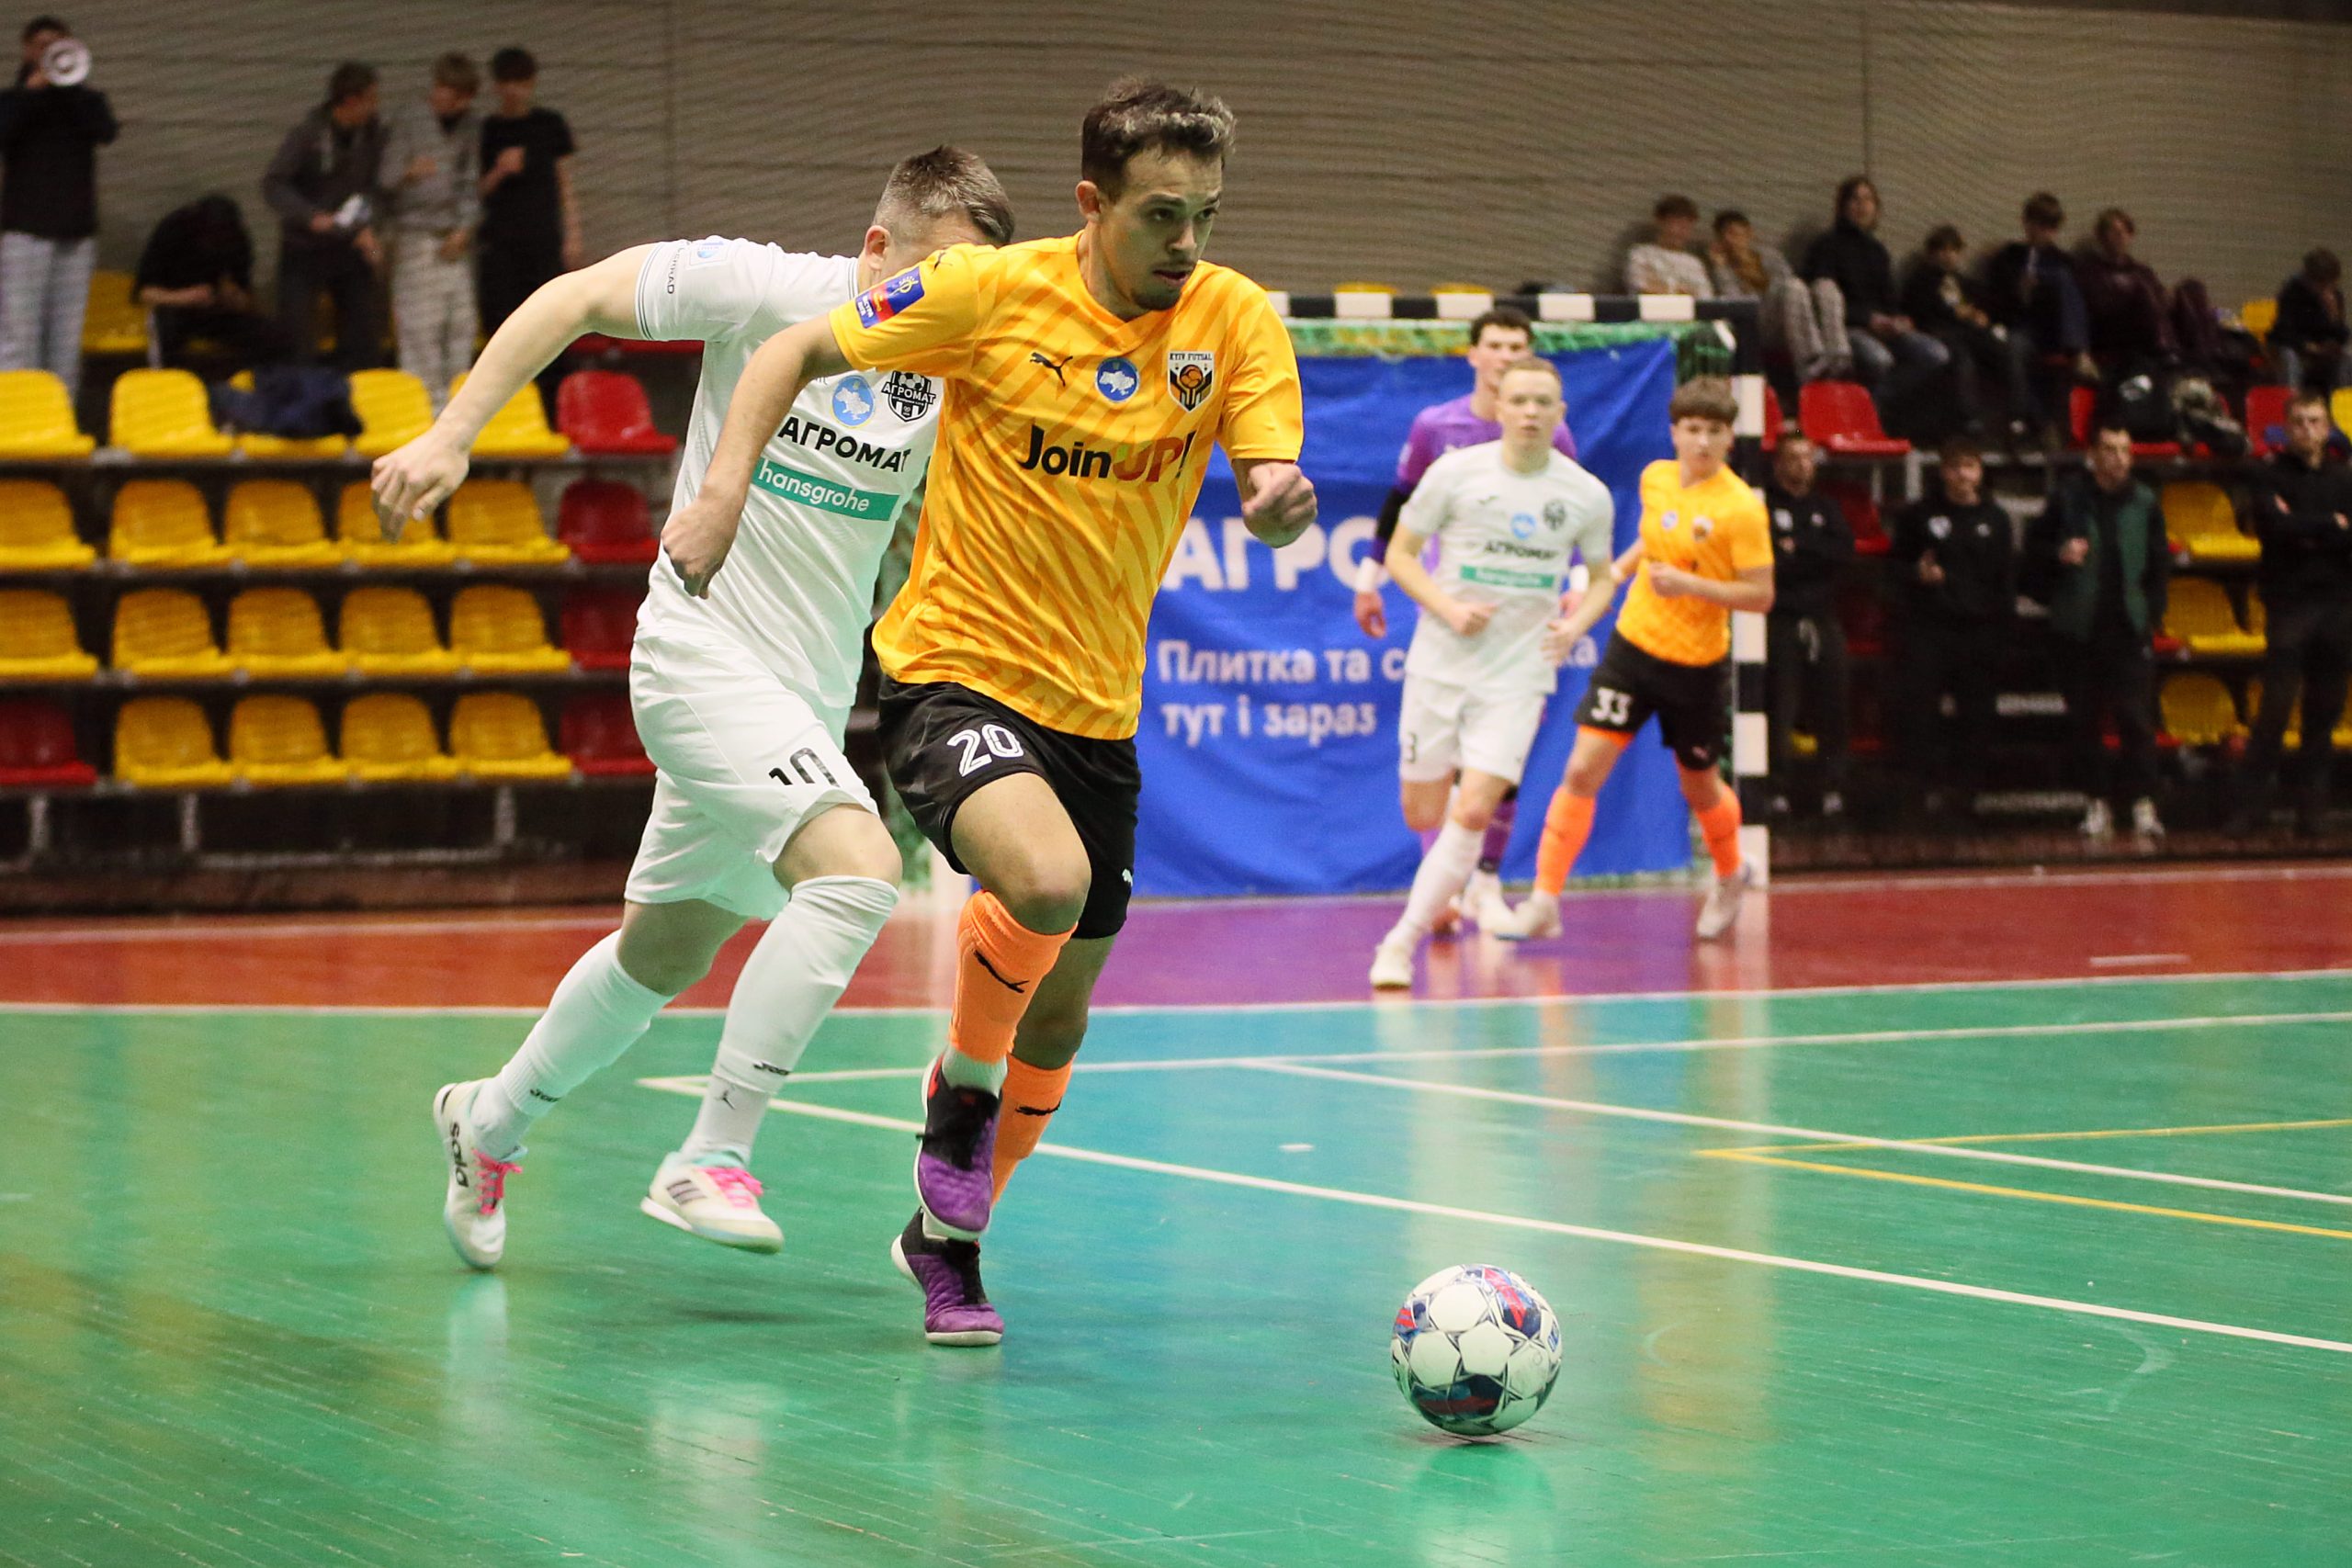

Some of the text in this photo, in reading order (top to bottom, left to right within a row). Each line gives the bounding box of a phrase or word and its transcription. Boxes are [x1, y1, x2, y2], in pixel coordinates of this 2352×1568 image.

[883, 382, 936, 403] АГРОМАТ
[777, 416, 911, 472] АГРОМАТ
[758, 459, 870, 512] hansgrohe
[1161, 514, 1391, 591] АГРО
[1158, 639, 1316, 683] Плитка
[1323, 649, 1371, 682] та
[1160, 694, 1376, 748] тут і зараз
[1591, 686, 1634, 726] 33
[946, 723, 1024, 778] 20
